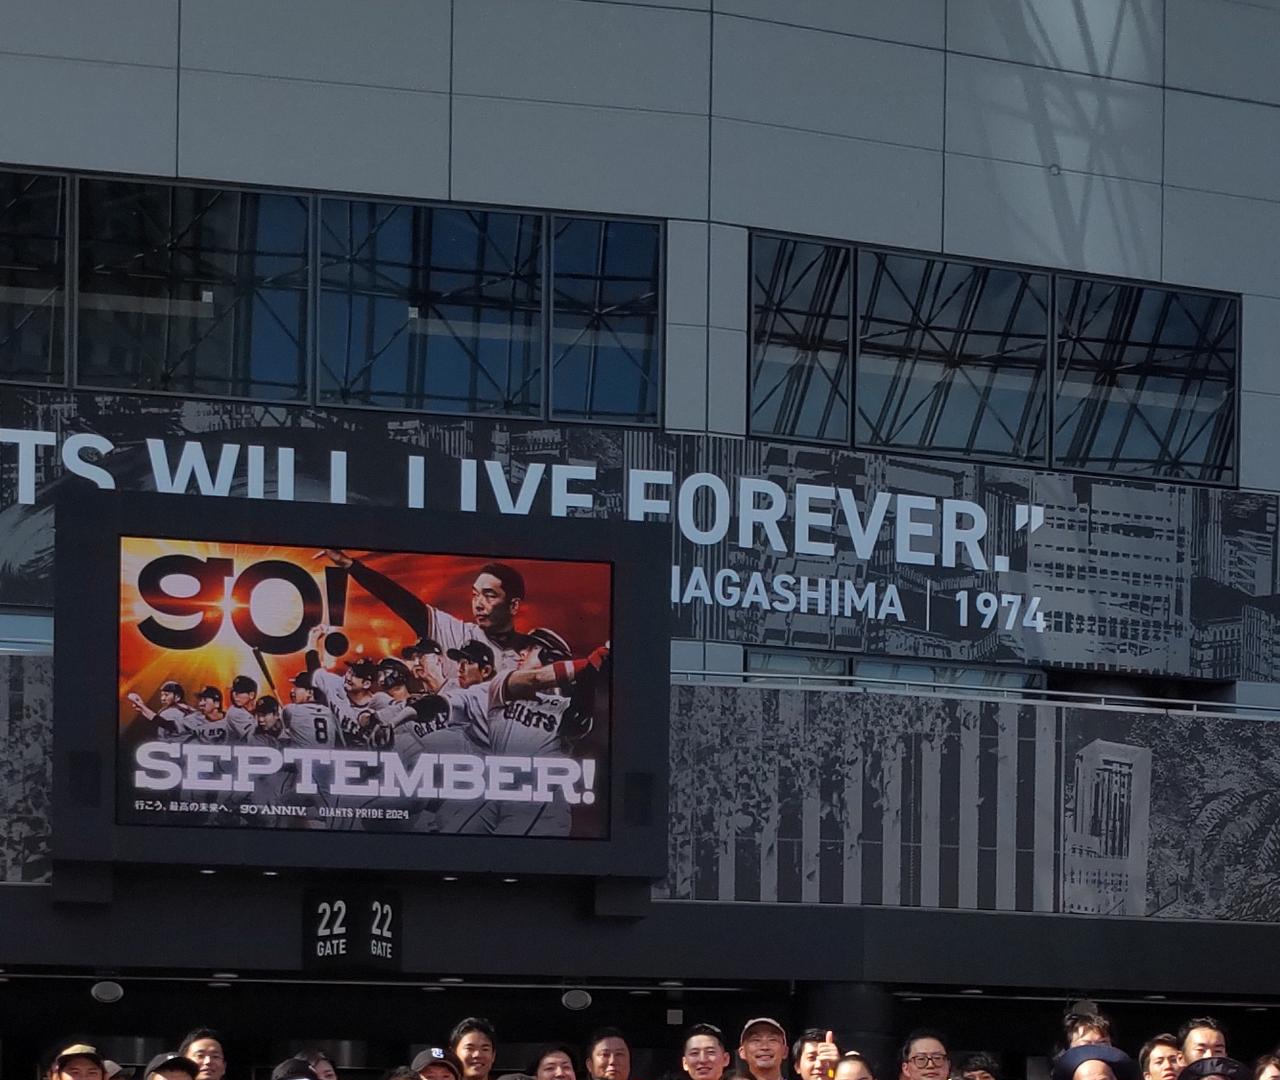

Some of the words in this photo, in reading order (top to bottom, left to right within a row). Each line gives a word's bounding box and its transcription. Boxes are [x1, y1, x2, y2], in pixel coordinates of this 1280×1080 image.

[671, 566, 906, 622] AGASHIMA
[954, 590, 1048, 634] 1974
[134, 740, 597, 805] SEPTEMBER!
[319, 807, 353, 818] GIANTS
[355, 808, 384, 819] PRIDE
[386, 809, 409, 820] 2024
[317, 900, 347, 937] 22
[371, 901, 393, 938] 22
[316, 938, 348, 957] GATE
[370, 939, 393, 959] GATE
